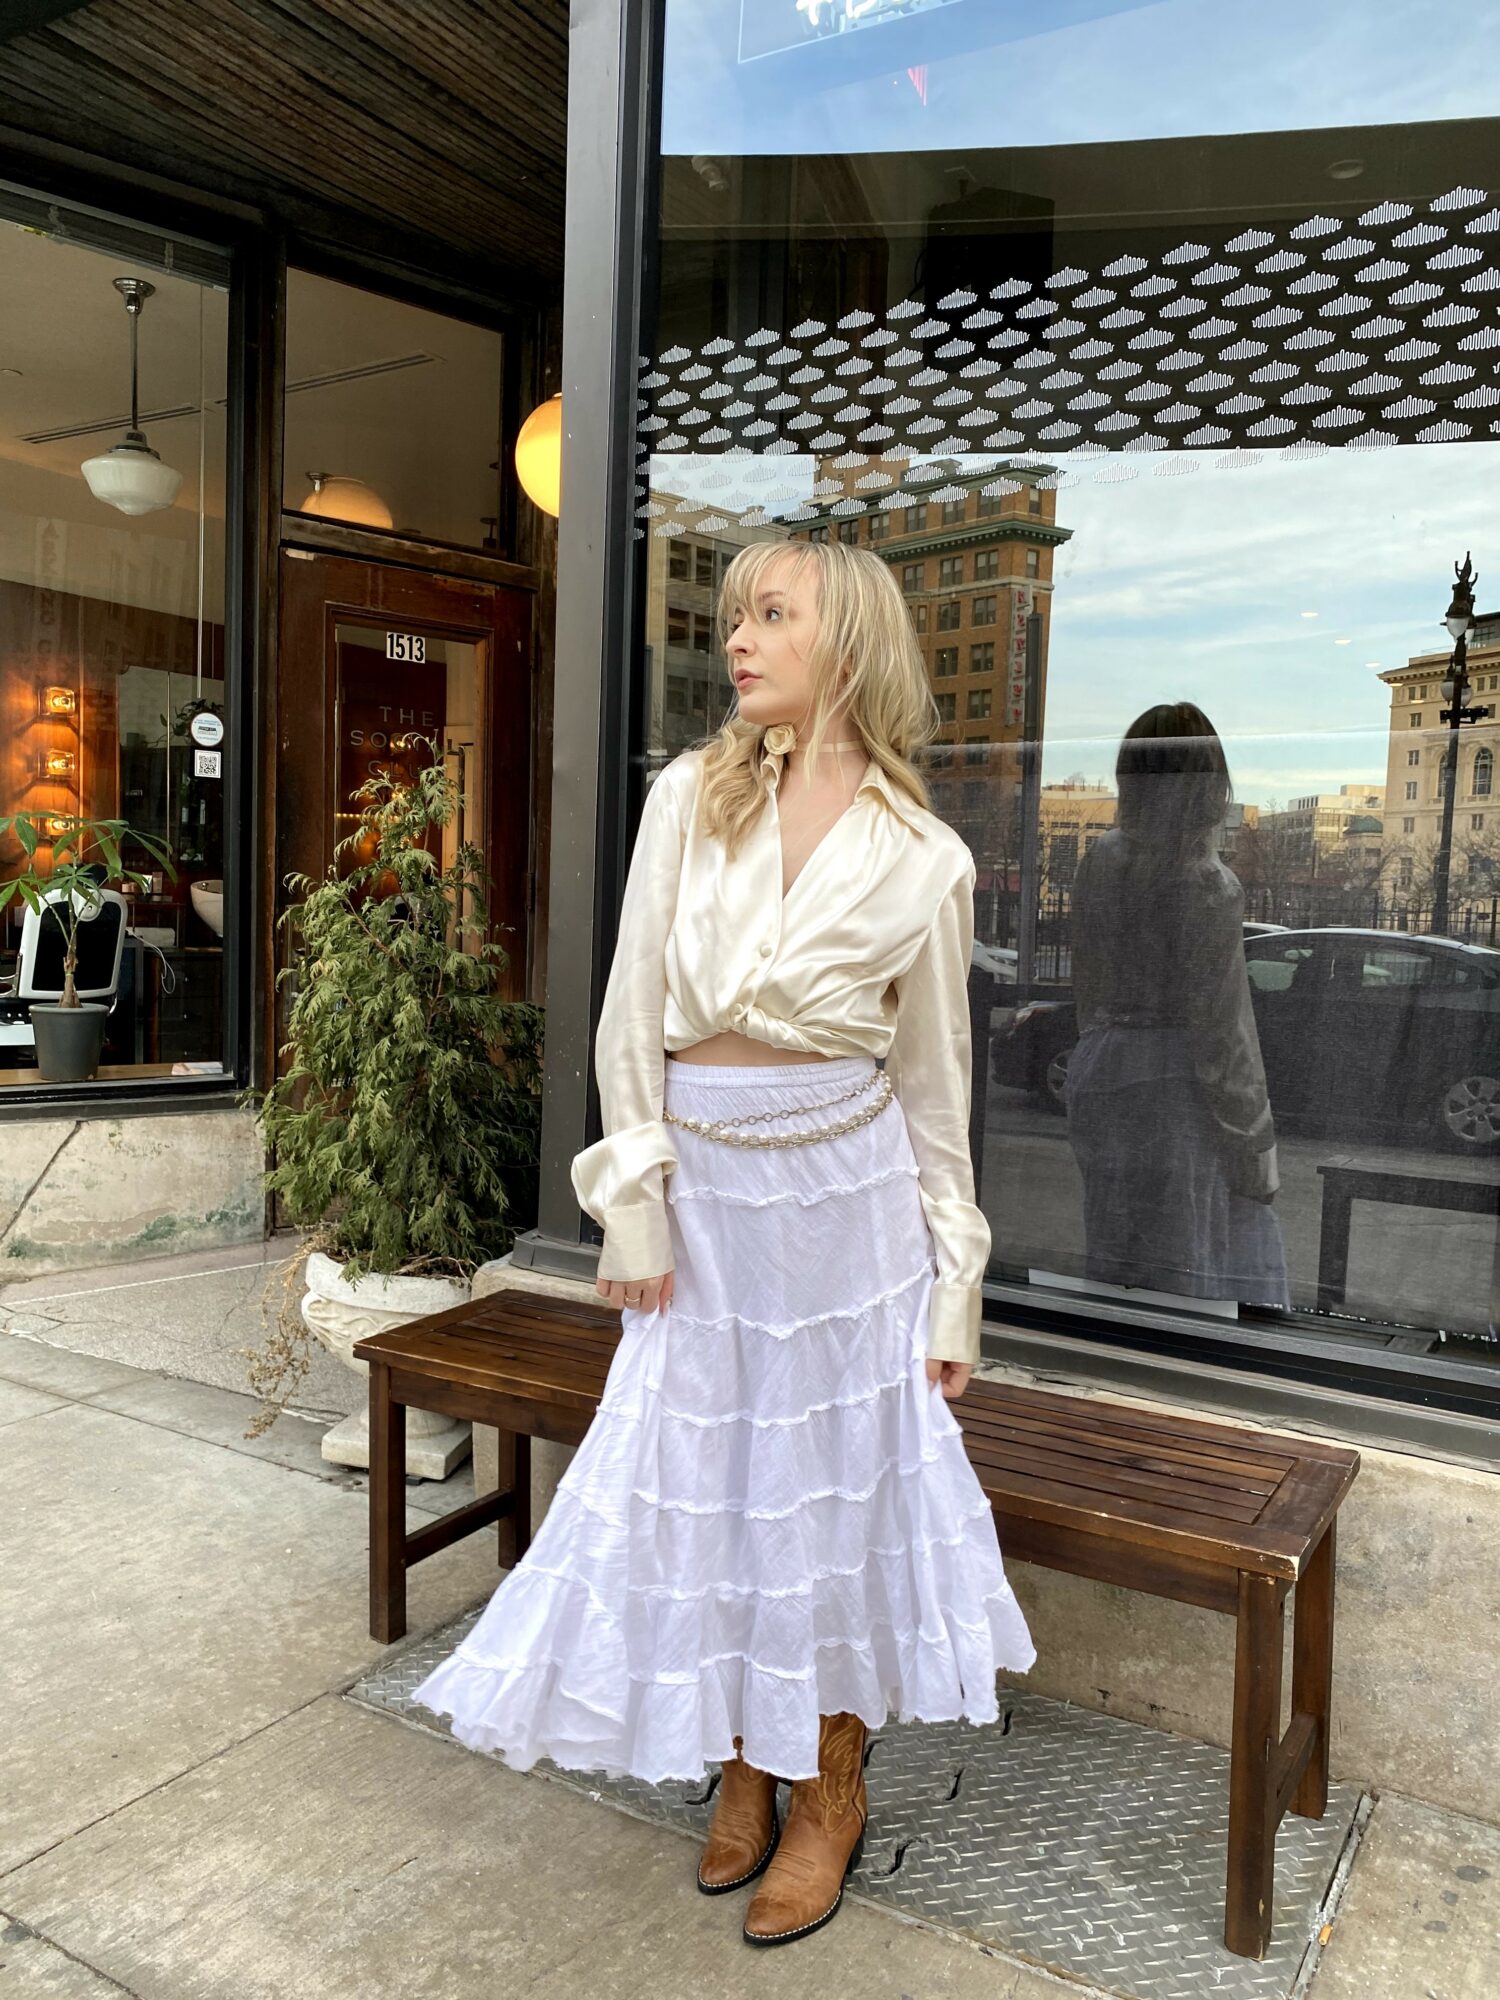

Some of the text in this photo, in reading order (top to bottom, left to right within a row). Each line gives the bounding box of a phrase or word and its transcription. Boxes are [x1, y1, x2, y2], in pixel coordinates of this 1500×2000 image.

[387, 632, 424, 663] 1513
[378, 706, 434, 727] THE
[367, 759, 424, 780] CLU
